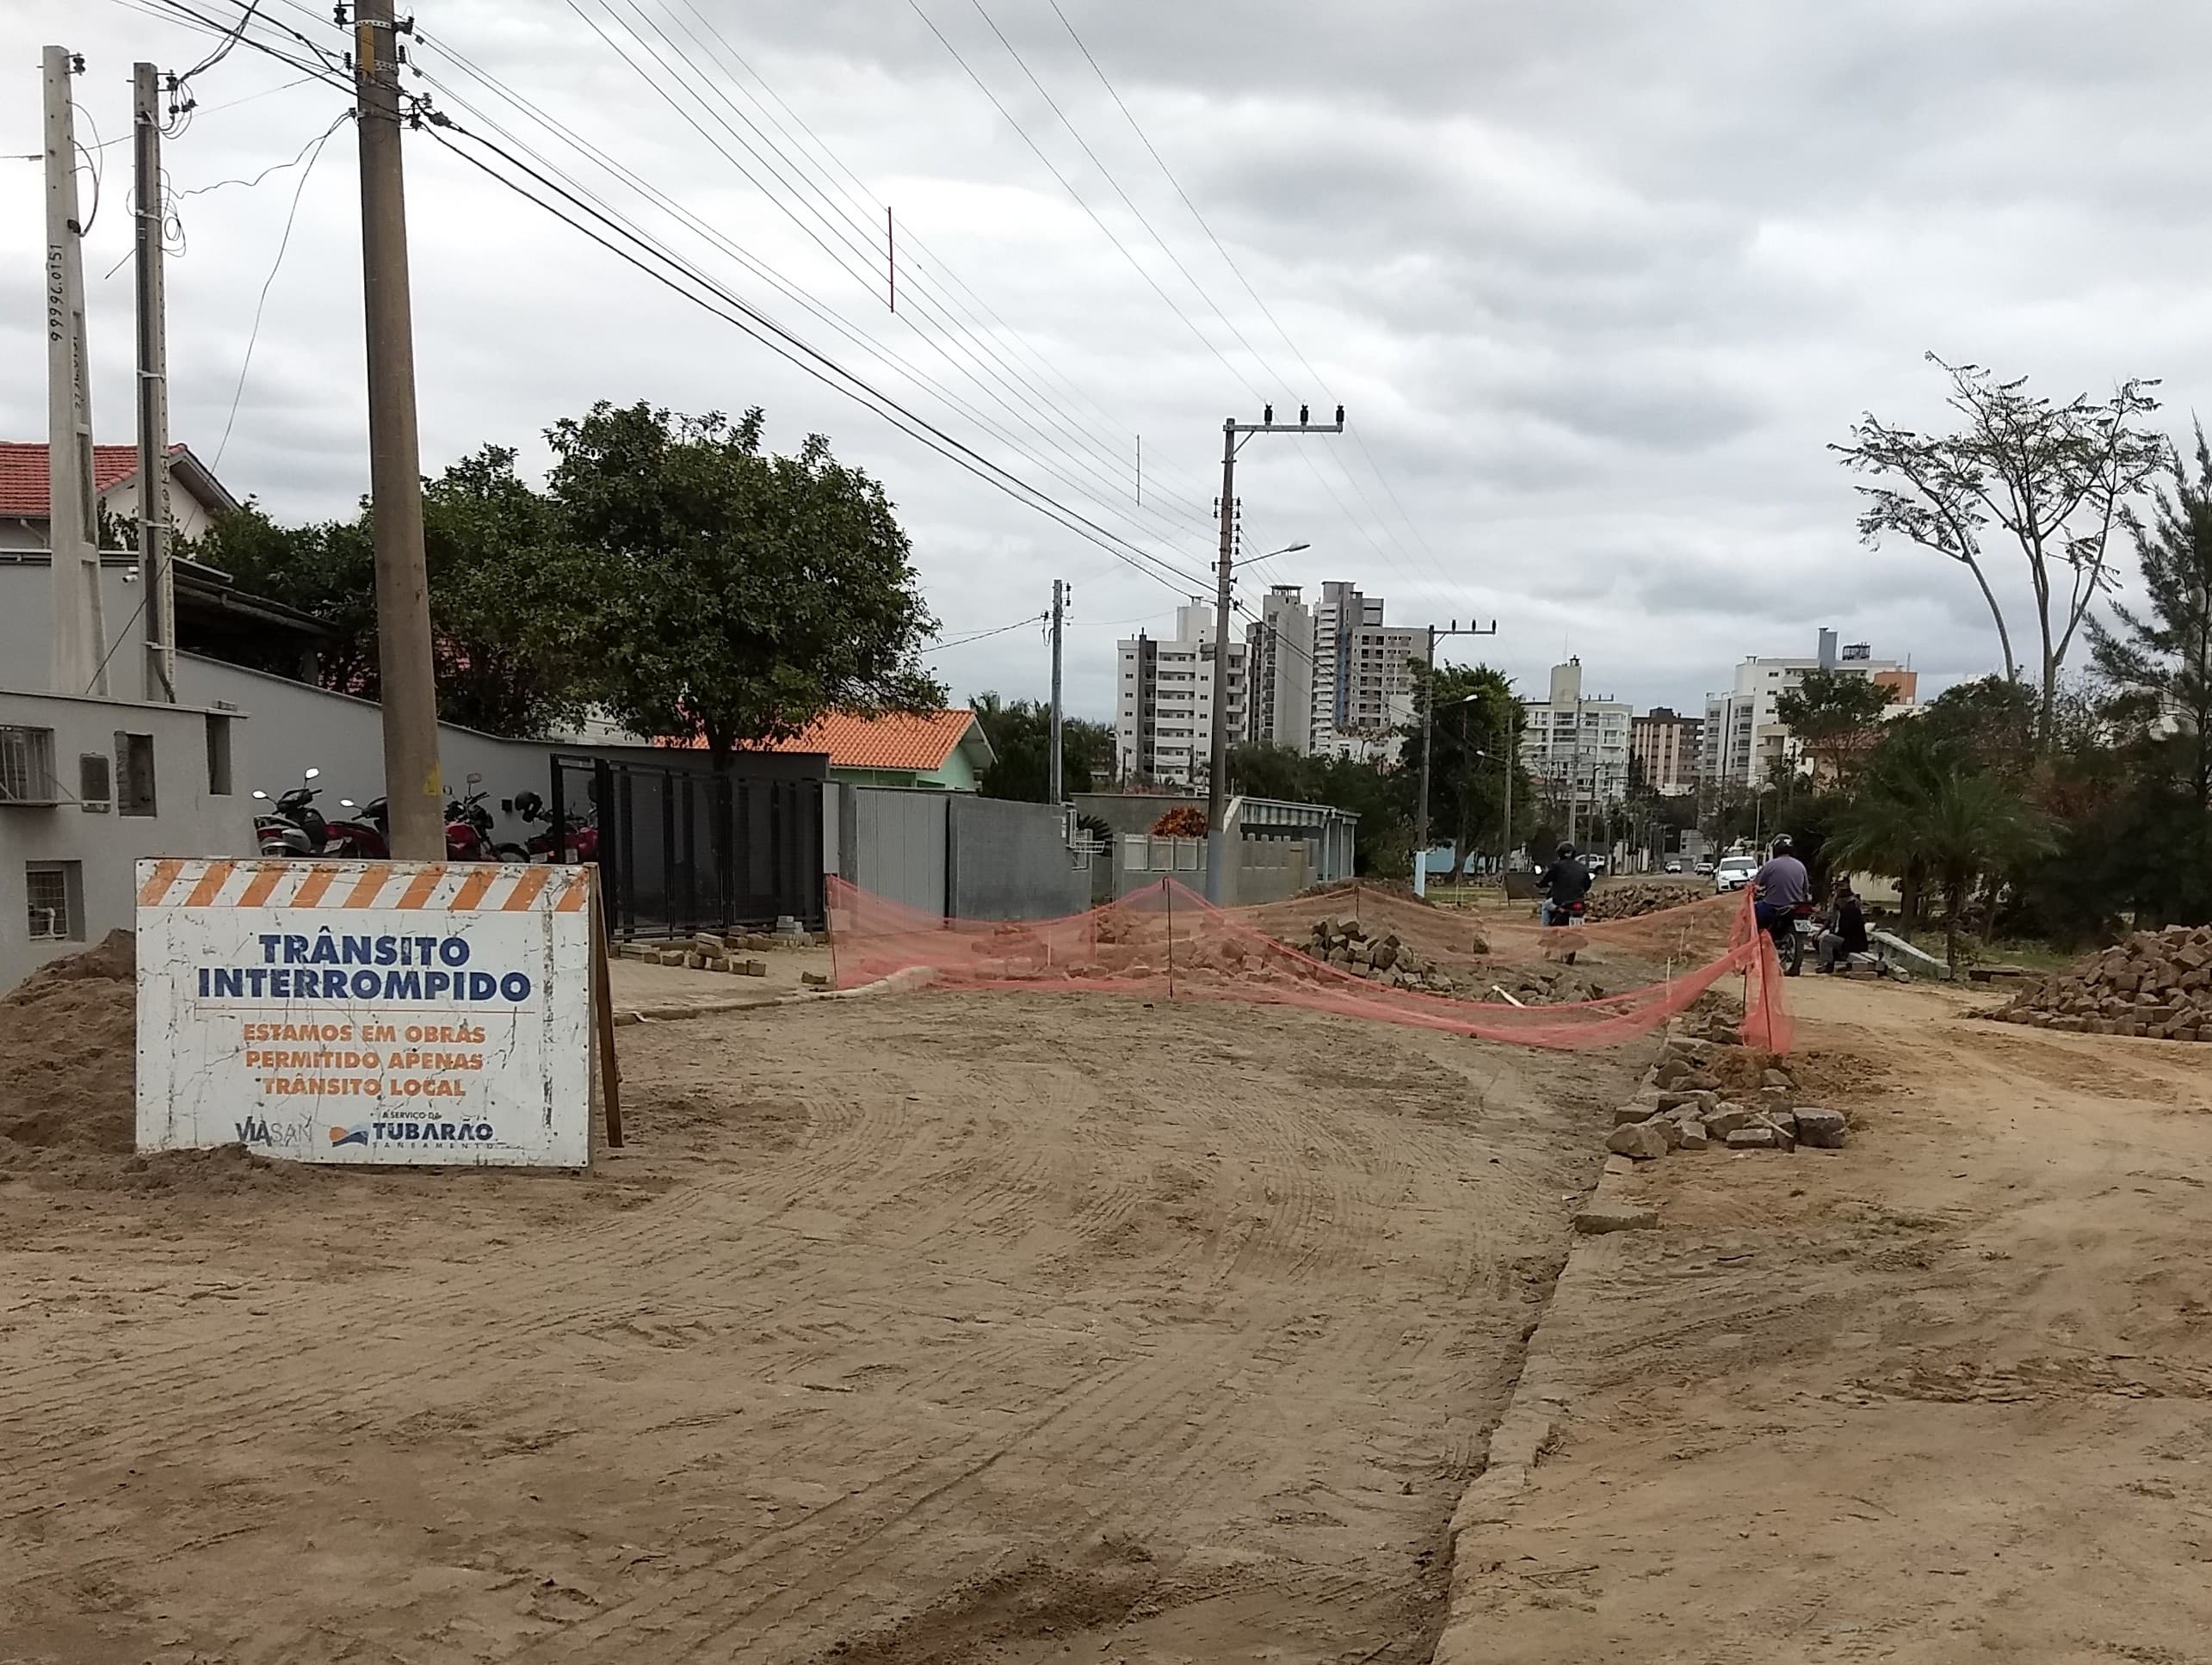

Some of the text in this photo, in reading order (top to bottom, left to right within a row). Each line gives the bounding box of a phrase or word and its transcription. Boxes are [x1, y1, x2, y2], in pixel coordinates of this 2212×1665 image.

[258, 925, 470, 966] TRÂNSITO
[199, 968, 531, 1002] INTERROMPIDO
[243, 1023, 485, 1043] ESTAMOS EM OBRAS
[246, 1051, 483, 1070] PERMITIDO APENAS
[263, 1074, 466, 1096] TRÂNSITO LOCAL
[391, 1111, 427, 1119] SERVIÇO
[373, 1118, 493, 1140] TUBARÃO
